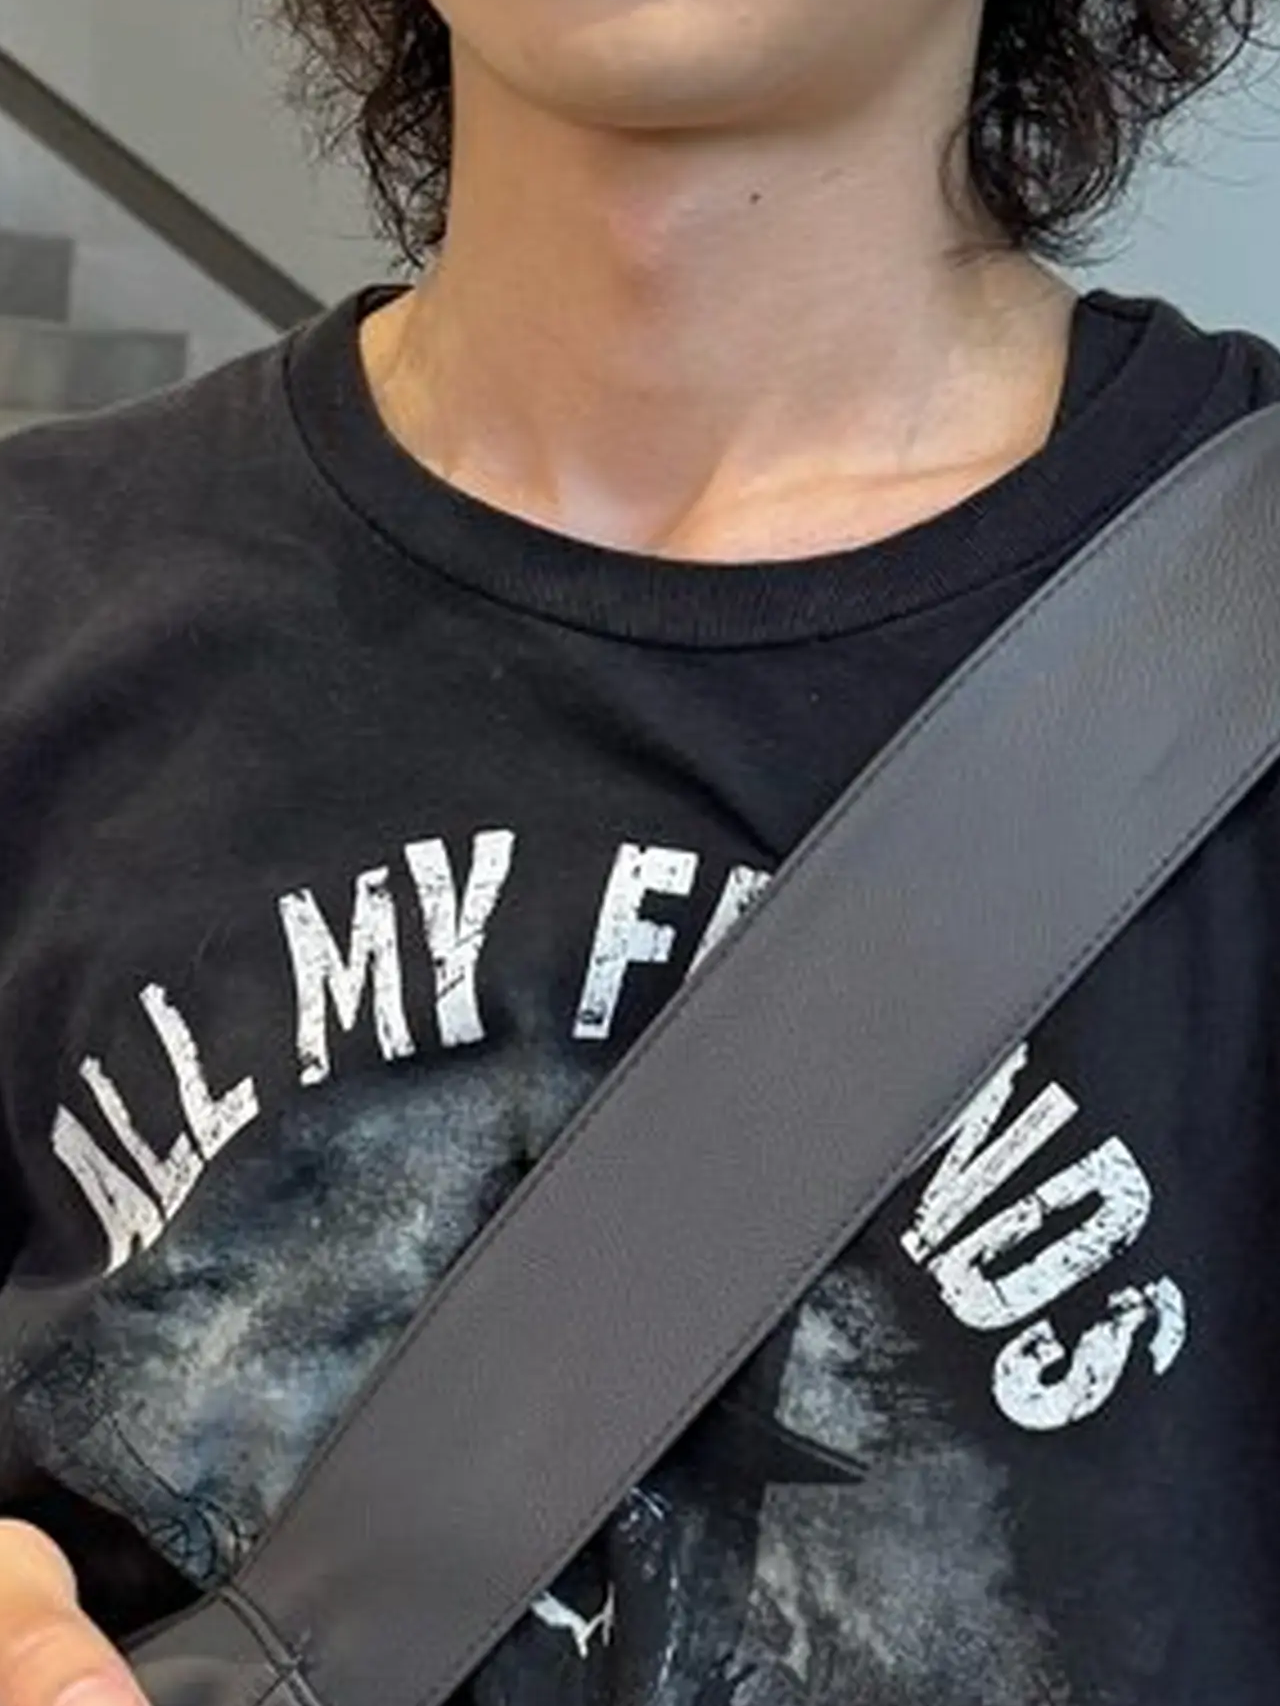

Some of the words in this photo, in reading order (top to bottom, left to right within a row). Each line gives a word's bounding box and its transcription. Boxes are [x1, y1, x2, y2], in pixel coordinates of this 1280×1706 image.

[52, 983, 260, 1277] ALL
[278, 829, 516, 1086] MY
[572, 842, 1187, 1432] FNDS
